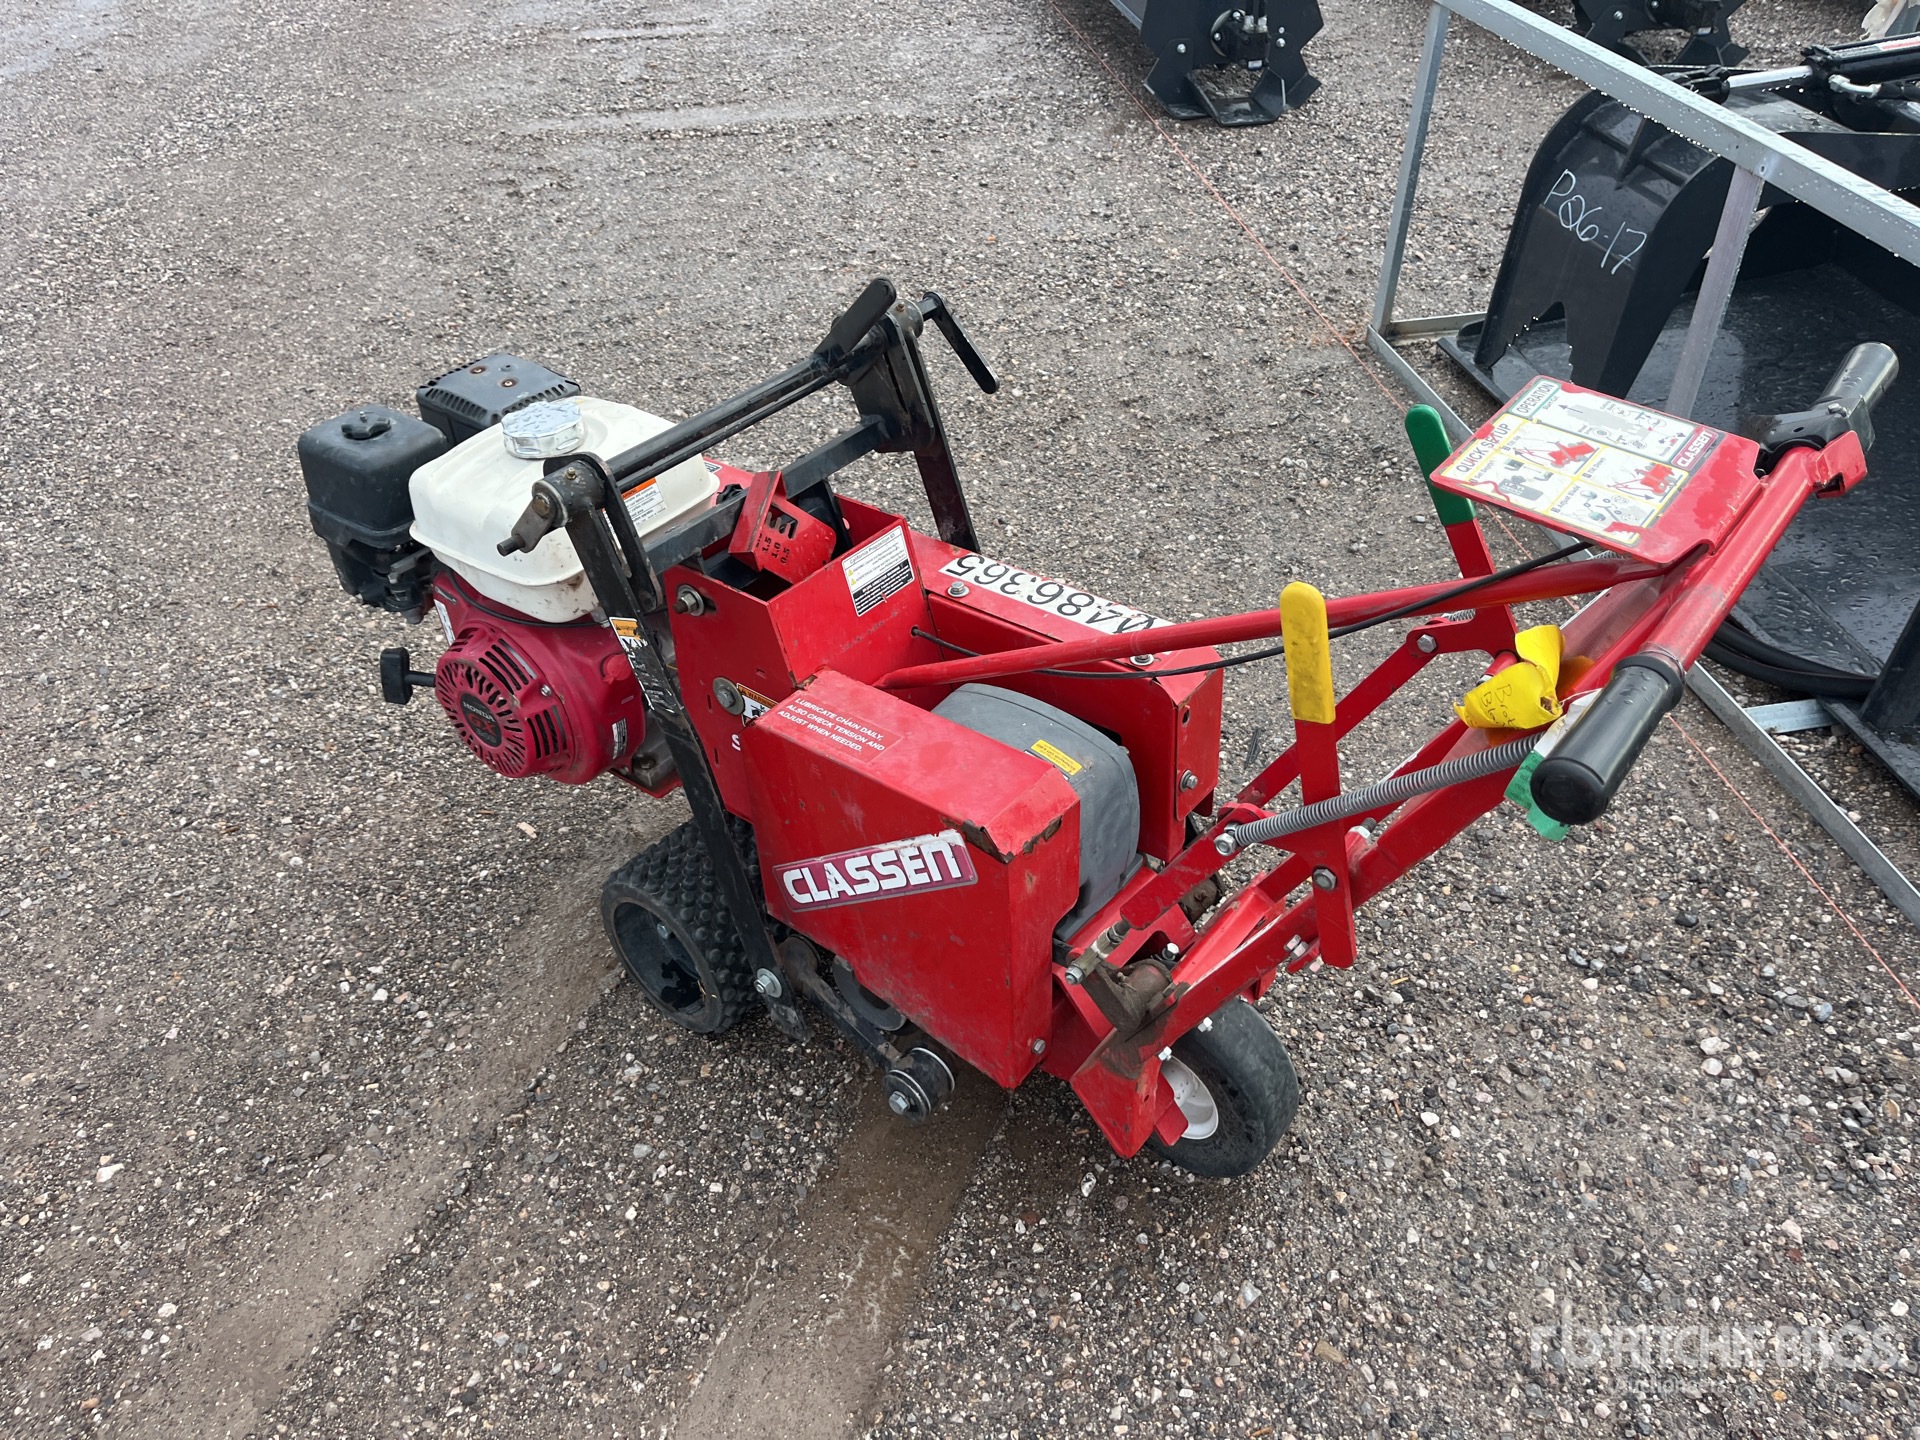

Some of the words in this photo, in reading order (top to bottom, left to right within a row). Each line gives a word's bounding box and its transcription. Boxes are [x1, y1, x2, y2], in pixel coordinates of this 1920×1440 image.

[1516, 383, 1555, 414] OPERATION
[1455, 447, 1489, 473] QUICK
[762, 536, 772, 553] 1.5
[771, 542, 781, 559] 1.0
[780, 547, 790, 564] 0.5
[463, 701, 496, 722] HONDA
[795, 697, 837, 719] LUBRICATE
[835, 716, 861, 731] CHAIN
[777, 710, 809, 726] ADJUST
[806, 722, 831, 737] WHEN
[829, 733, 863, 752] NEEDED.
[786, 704, 808, 716] ALSO
[807, 713, 835, 728] CHECK
[833, 725, 868, 744] TENSION
[866, 741, 885, 752] AND
[782, 840, 962, 904] CLASSEN
